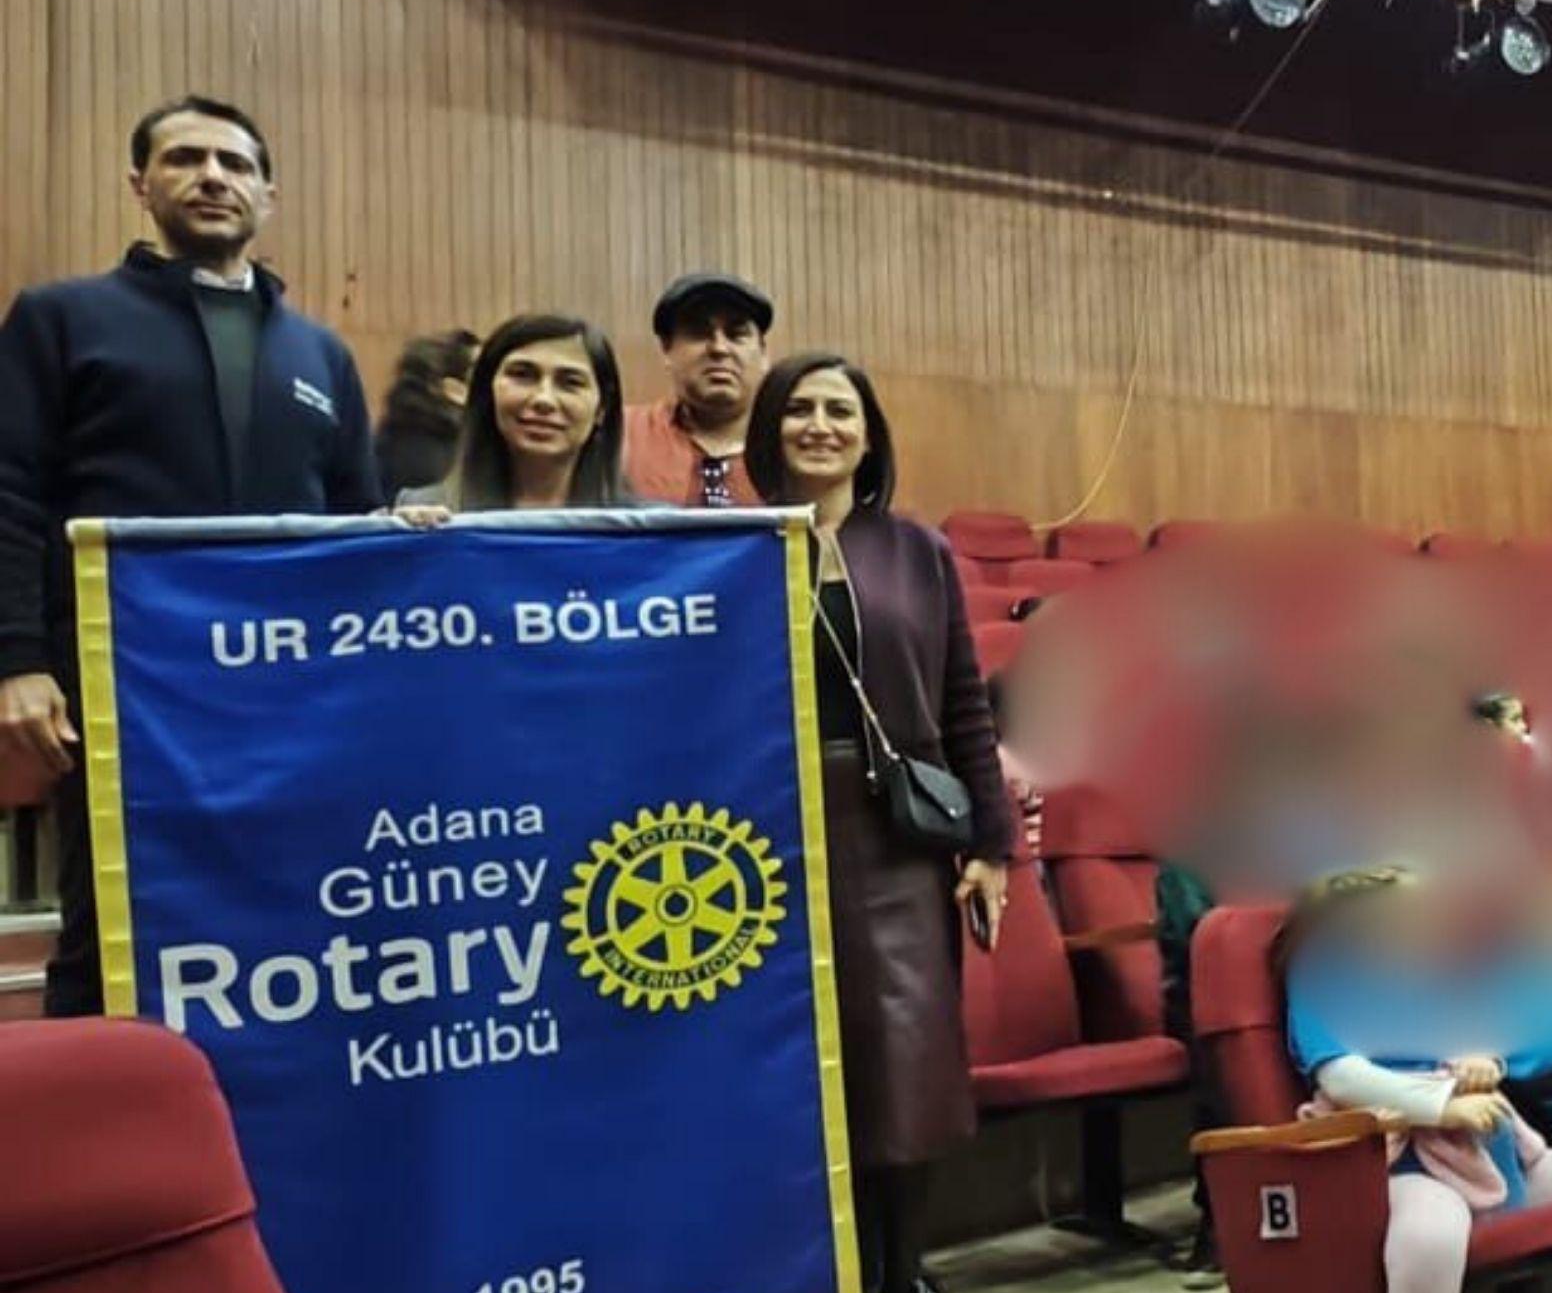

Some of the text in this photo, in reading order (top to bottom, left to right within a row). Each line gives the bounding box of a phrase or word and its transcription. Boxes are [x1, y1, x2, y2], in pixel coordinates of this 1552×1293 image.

[211, 591, 718, 667] UR 2430. BÖLGE
[365, 802, 545, 851] Adana
[627, 823, 716, 853] ROTARY
[319, 857, 549, 918] Güney
[159, 921, 551, 1034] Rotary
[604, 925, 758, 989] INTERNATIONAL
[348, 1009, 560, 1086] Kulübü
[1267, 1192, 1290, 1231] B
